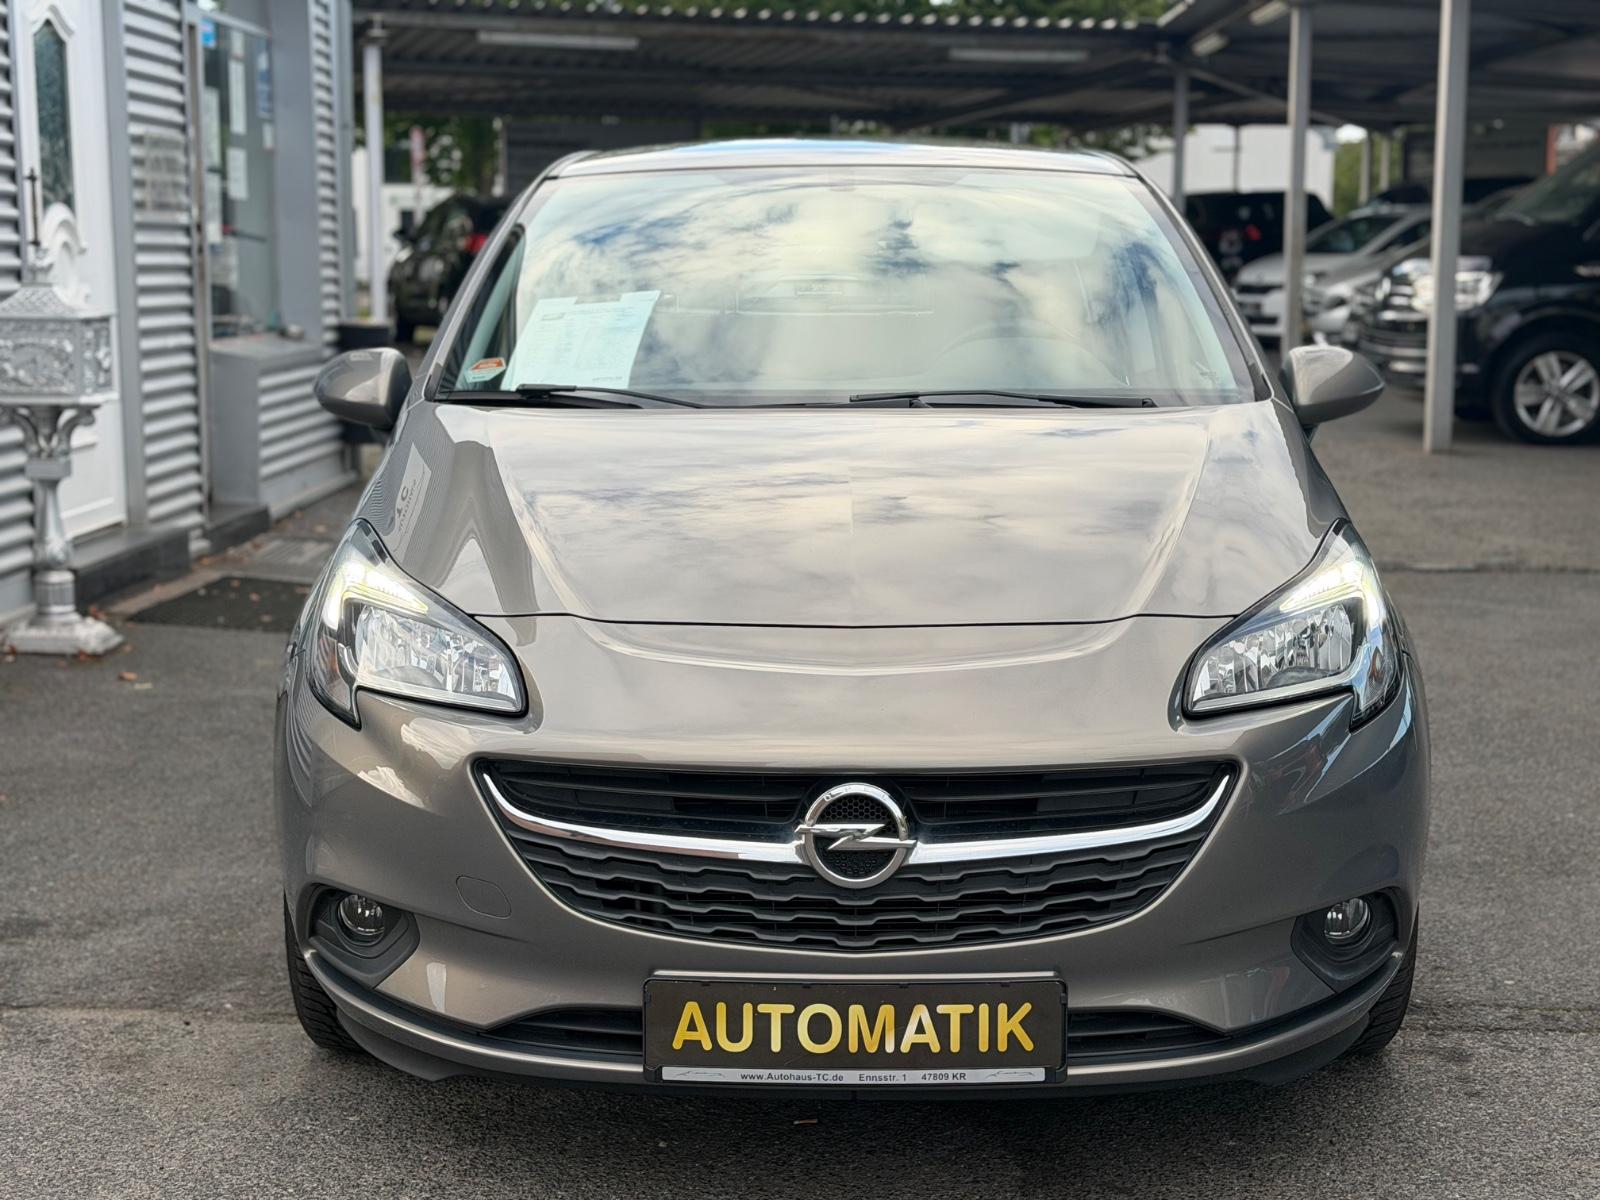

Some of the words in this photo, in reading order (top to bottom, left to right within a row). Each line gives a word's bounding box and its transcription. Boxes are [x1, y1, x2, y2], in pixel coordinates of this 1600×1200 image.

[672, 1001, 1034, 1053] AUTOMATIK
[740, 1072, 844, 1082] www.Autohaus-TC.de
[859, 1073, 899, 1082] Ennsstr.
[902, 1073, 907, 1082] 1
[921, 1073, 949, 1081] 47809
[952, 1073, 967, 1081] KR
